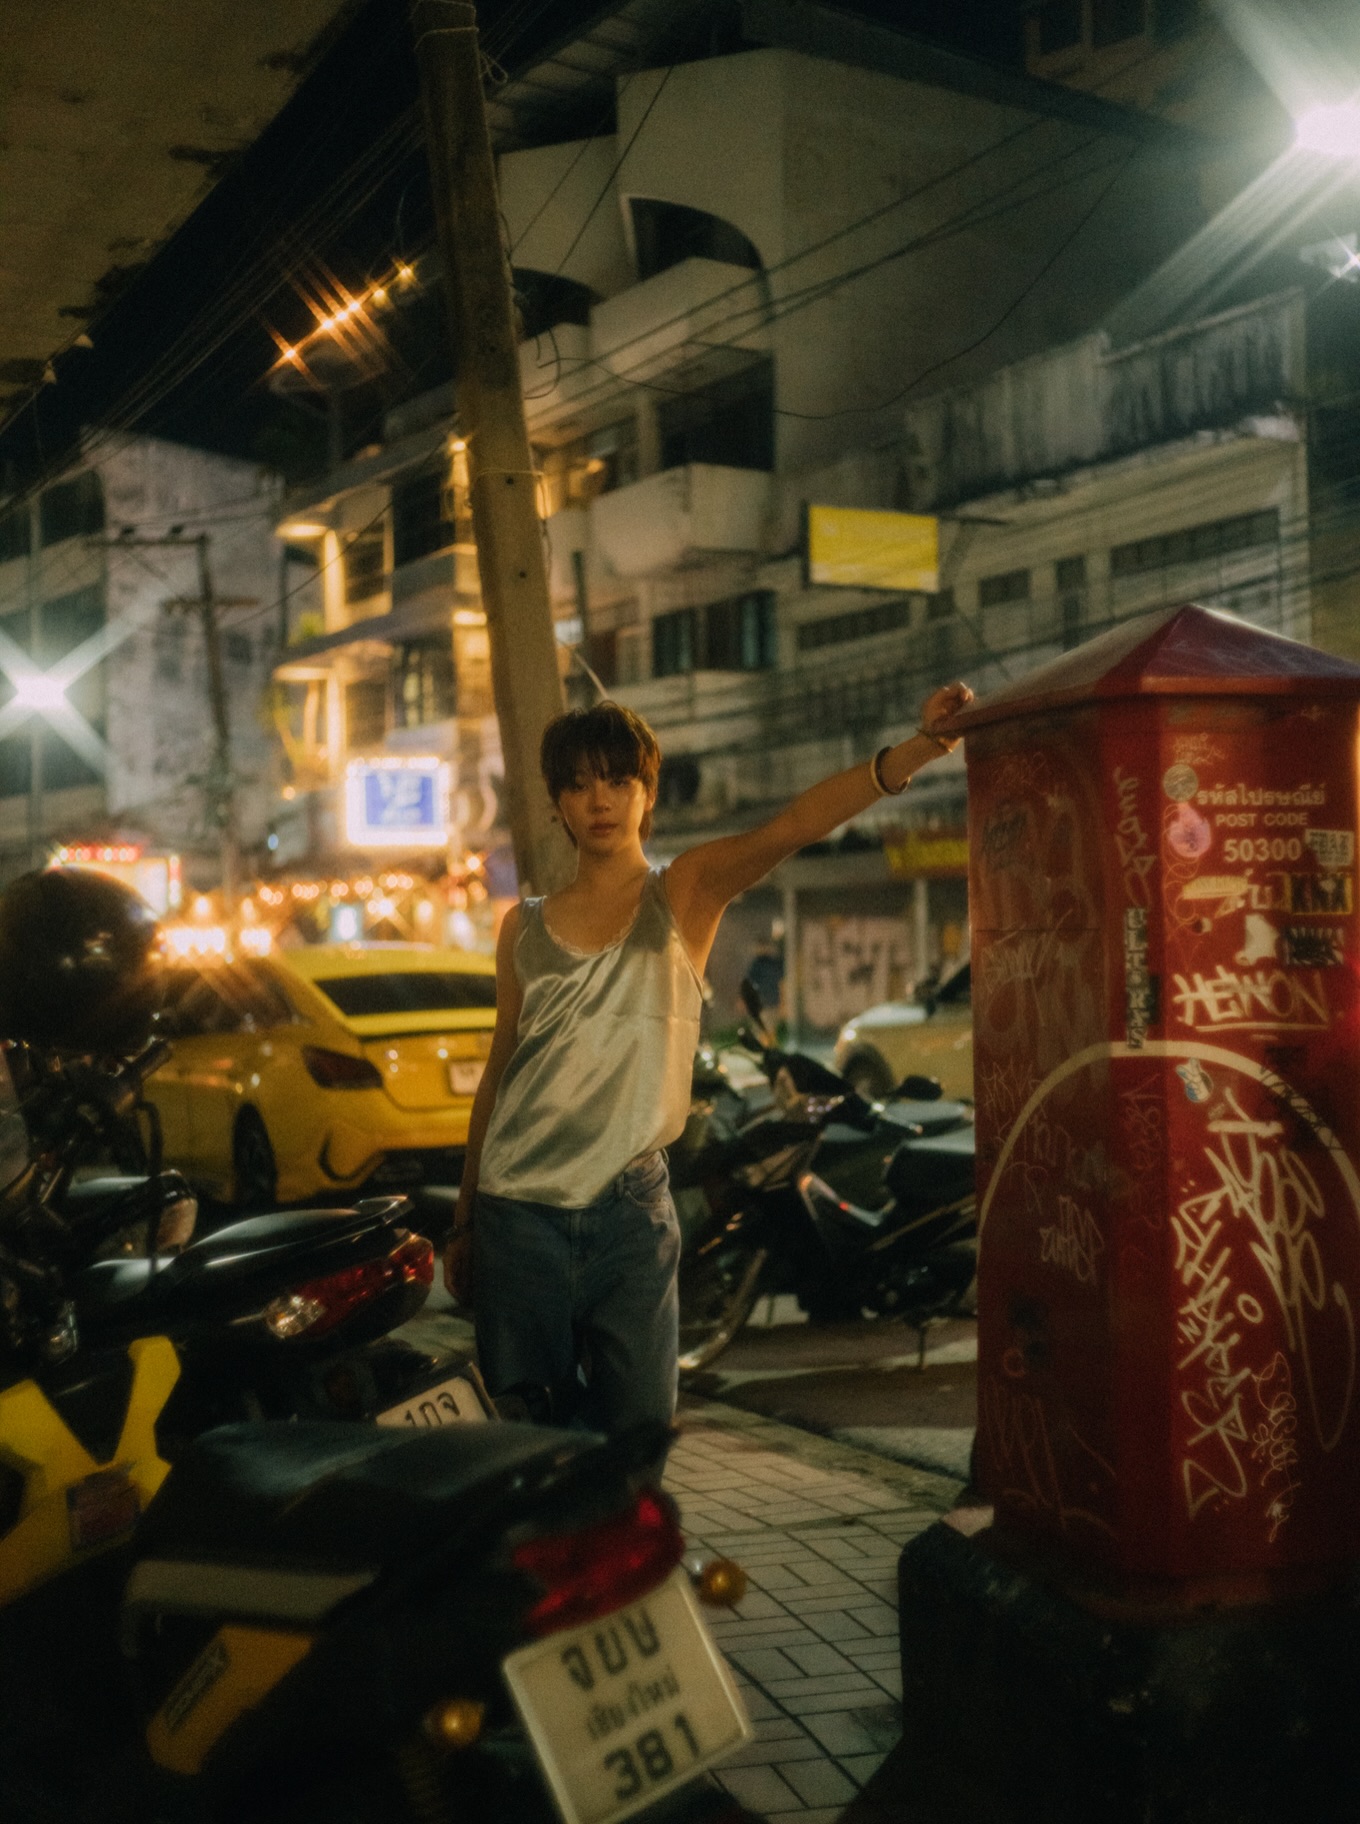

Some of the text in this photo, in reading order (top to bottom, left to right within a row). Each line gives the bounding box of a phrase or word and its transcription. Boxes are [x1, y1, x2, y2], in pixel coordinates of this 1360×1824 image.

[1197, 784, 1325, 807] รหัสไปรษณีย์
[1215, 811, 1309, 828] POST CODE
[1224, 837, 1302, 863] 50300
[603, 1712, 700, 1800] 381
